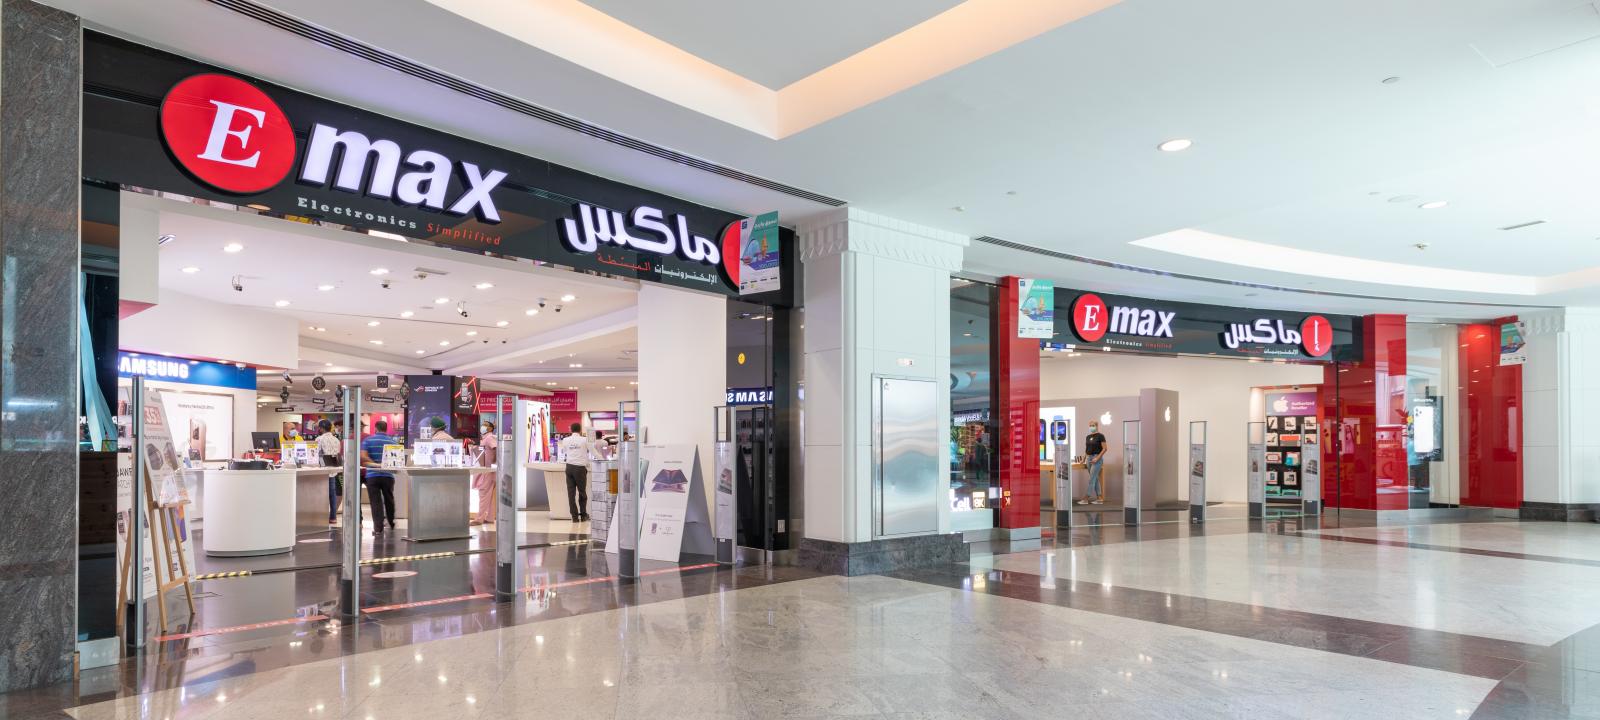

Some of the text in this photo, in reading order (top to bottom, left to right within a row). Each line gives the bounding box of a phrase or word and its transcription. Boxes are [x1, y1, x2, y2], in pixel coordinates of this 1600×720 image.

[297, 197, 501, 245] Electronics Simplified
[118, 356, 189, 379] AMSUNG
